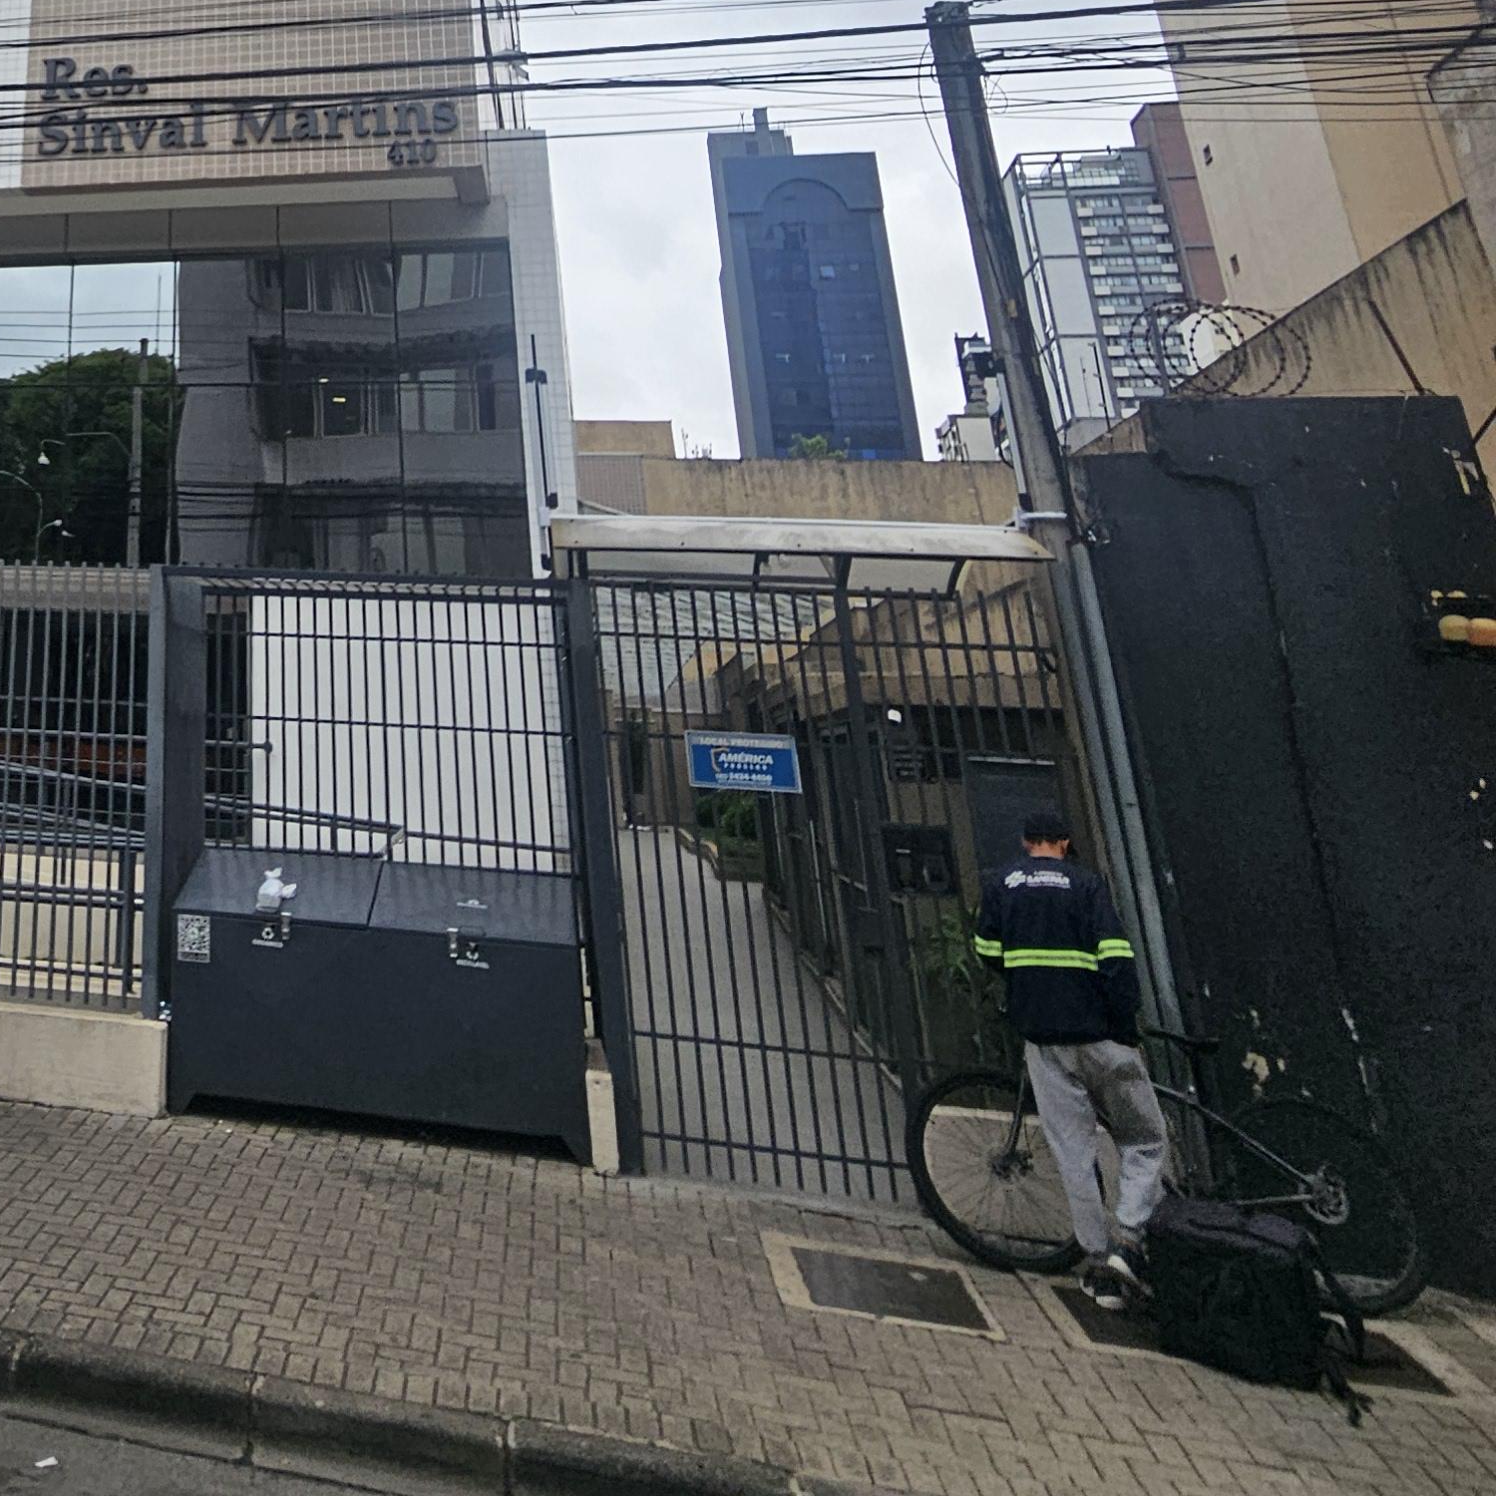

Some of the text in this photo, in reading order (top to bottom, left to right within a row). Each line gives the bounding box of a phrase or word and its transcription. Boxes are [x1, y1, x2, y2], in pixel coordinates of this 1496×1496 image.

[41, 57, 149, 101] Res.
[38, 99, 458, 156] Sinval Martins
[387, 138, 437, 165] 410
[718, 751, 774, 765] AMÉRICA
